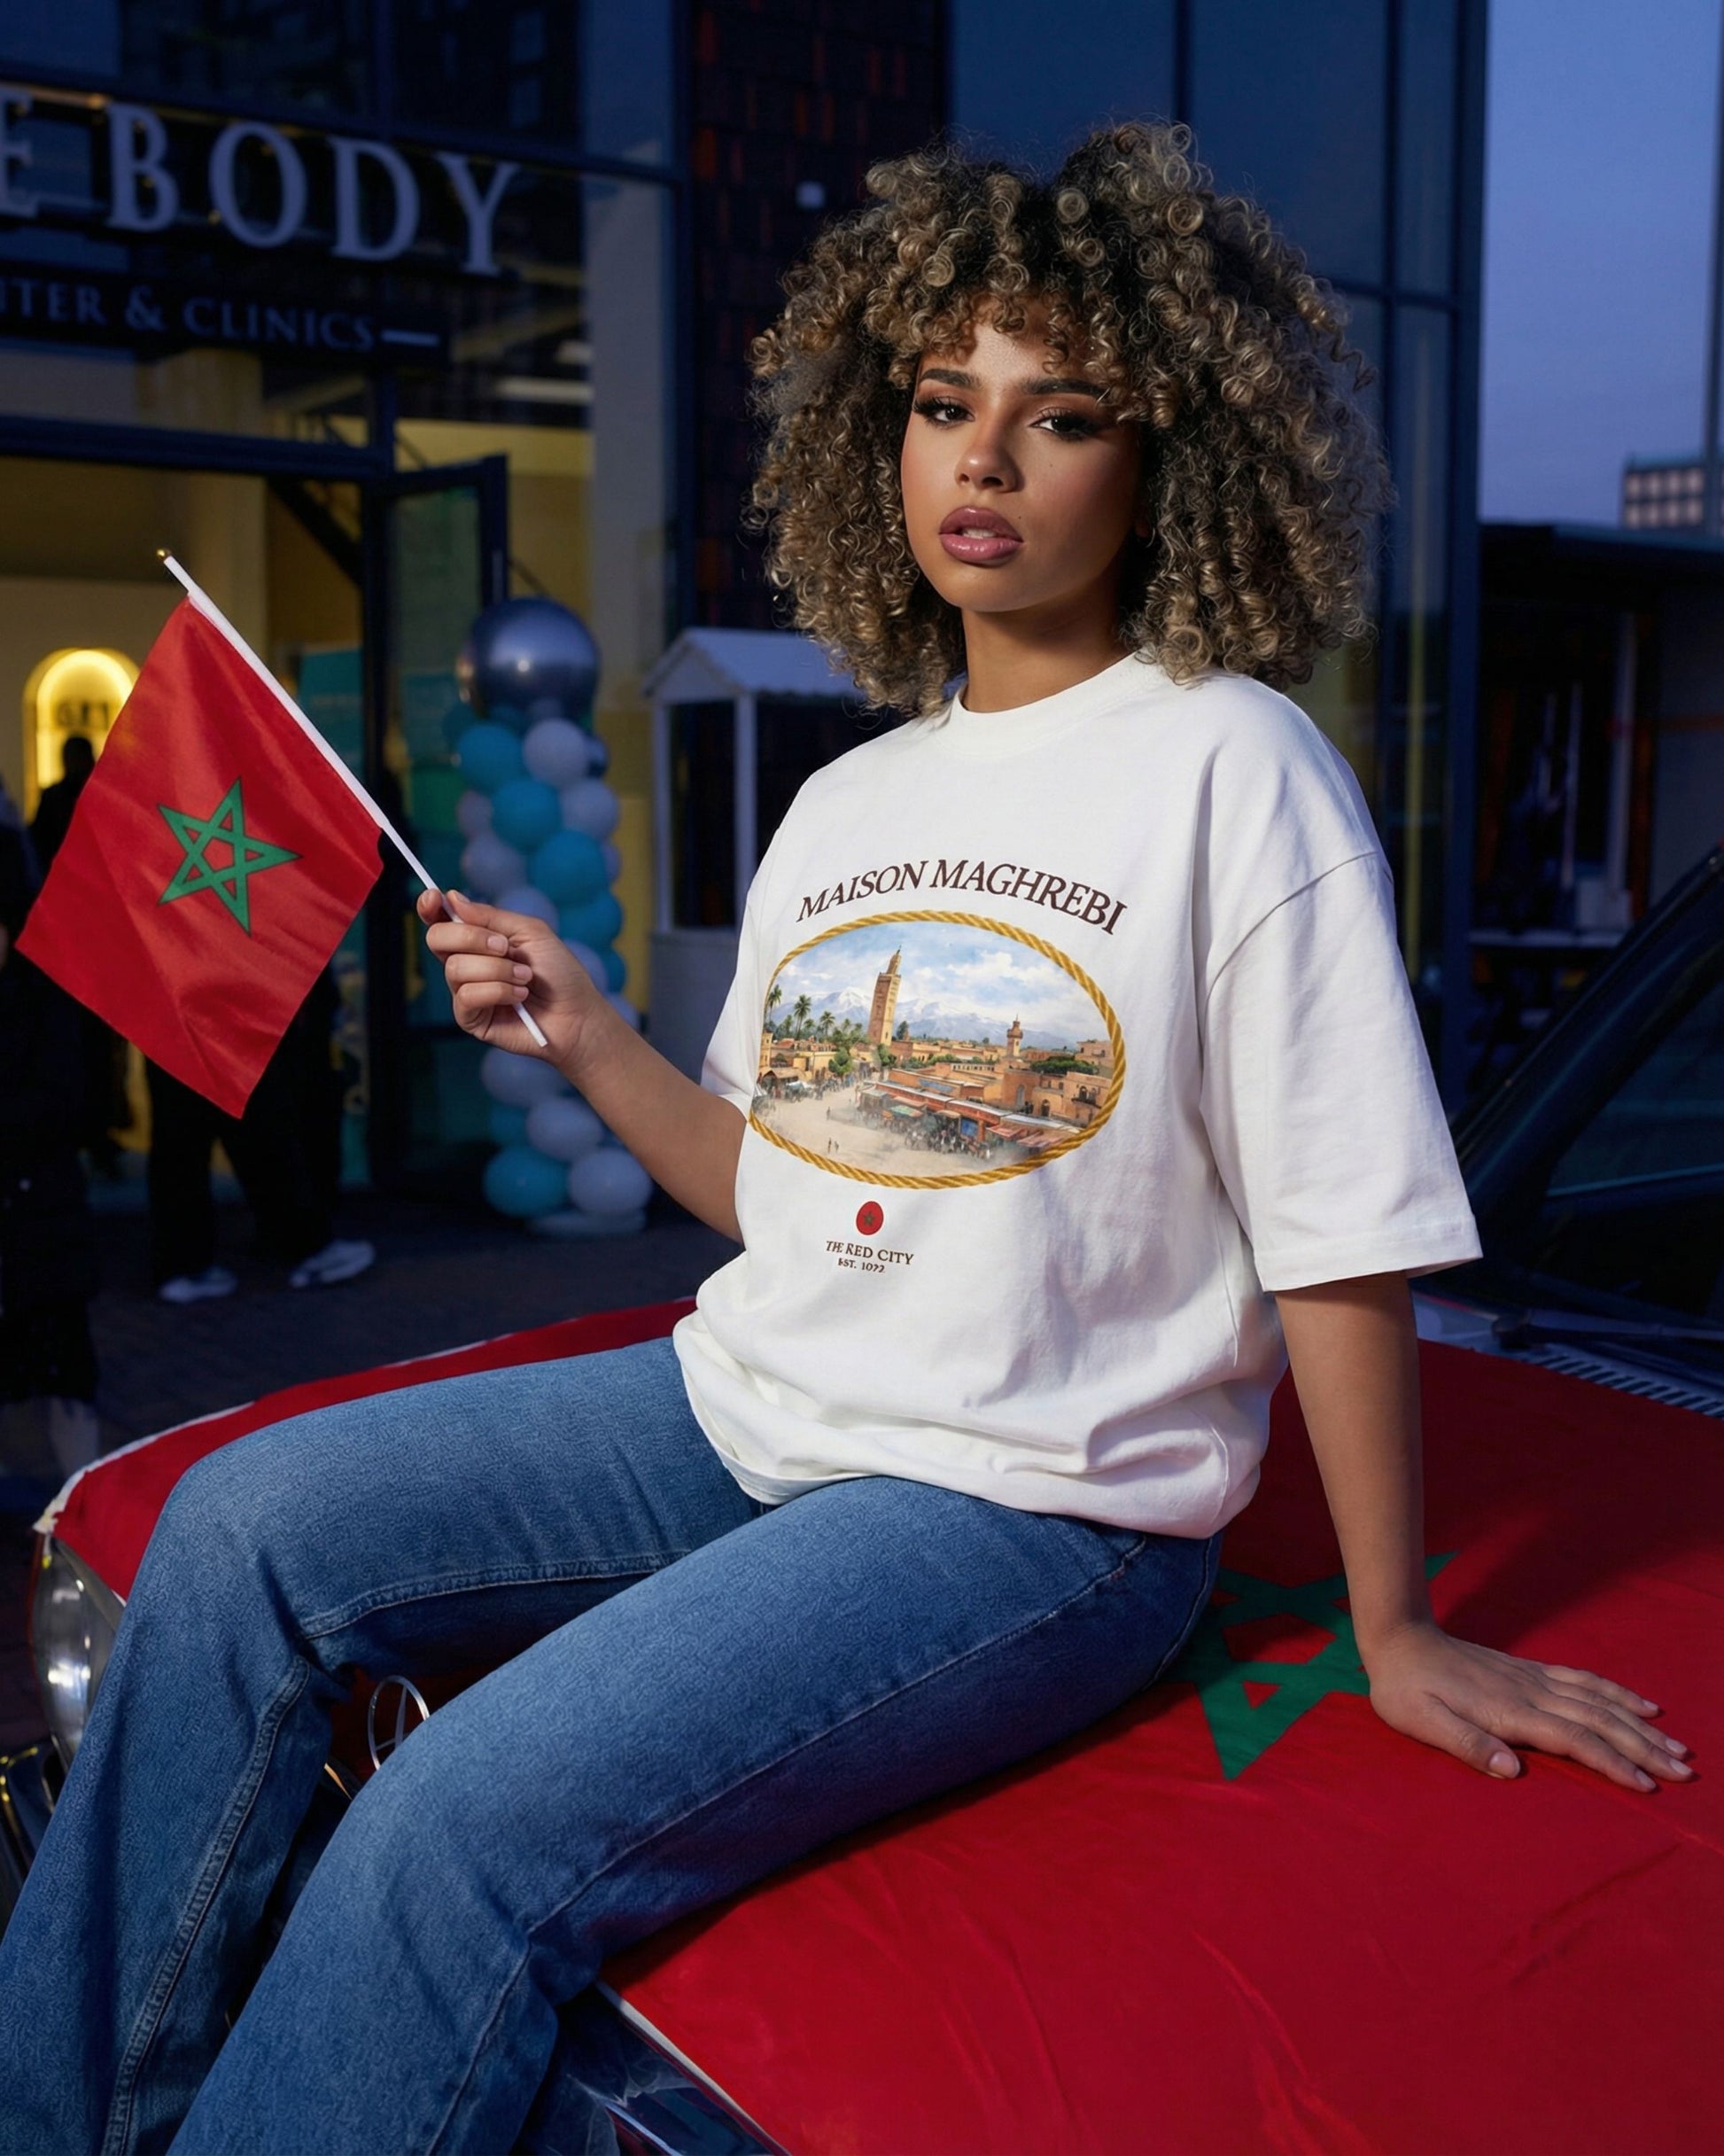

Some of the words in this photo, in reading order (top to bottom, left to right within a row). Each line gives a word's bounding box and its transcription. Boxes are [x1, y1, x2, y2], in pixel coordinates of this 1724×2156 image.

[104, 100, 521, 277] BODY
[0, 276, 109, 326] TER
[124, 284, 167, 332] &
[182, 295, 375, 353] CLINICS
[796, 860, 928, 922] MAISON
[930, 860, 1127, 935] MAGHREBI
[826, 1241, 844, 1253] THE
[845, 1242, 874, 1258] RED
[877, 1249, 914, 1265] CITY
[837, 1257, 857, 1269] EST.
